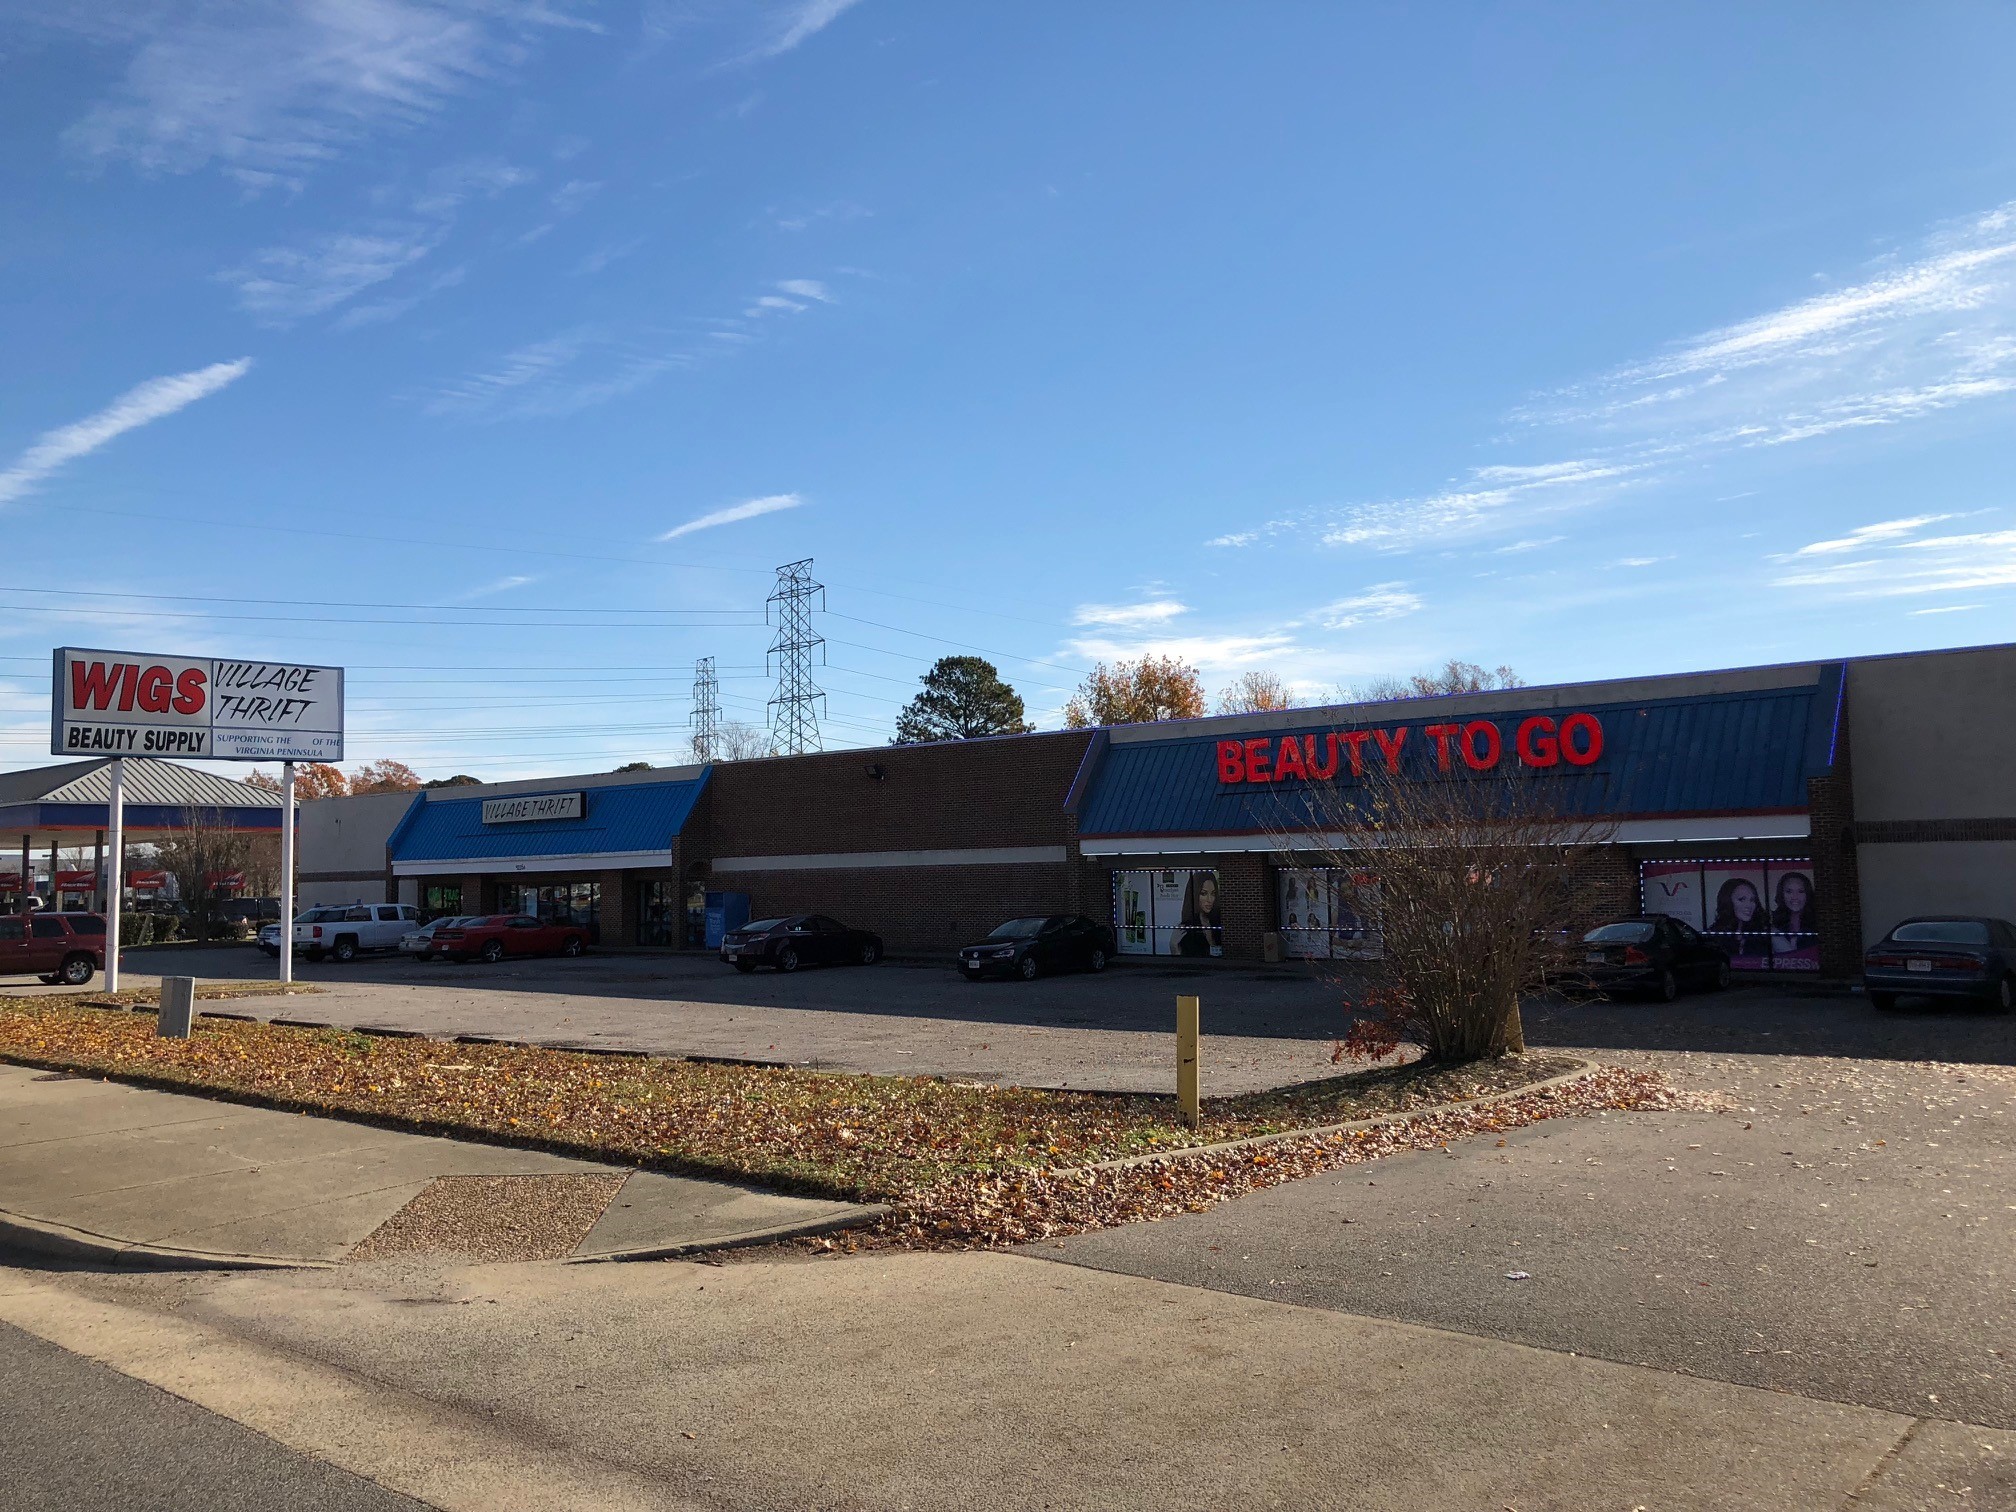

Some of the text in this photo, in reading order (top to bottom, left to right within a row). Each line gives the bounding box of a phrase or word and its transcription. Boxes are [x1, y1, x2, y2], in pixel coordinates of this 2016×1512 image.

[71, 660, 208, 715] WIGS
[214, 661, 321, 693] VILLAGE
[215, 694, 318, 724] THRIFT
[68, 726, 206, 753] BEAUTY SUPPLY
[216, 733, 341, 747] SUPPORTING THE OF THE
[235, 746, 323, 757] VIRGINIA PENINSULA
[1216, 712, 1603, 784] BEAUTY TO GO
[485, 797, 576, 820] VILLAGE THRIFT
[1760, 957, 1811, 970] EPRESS
